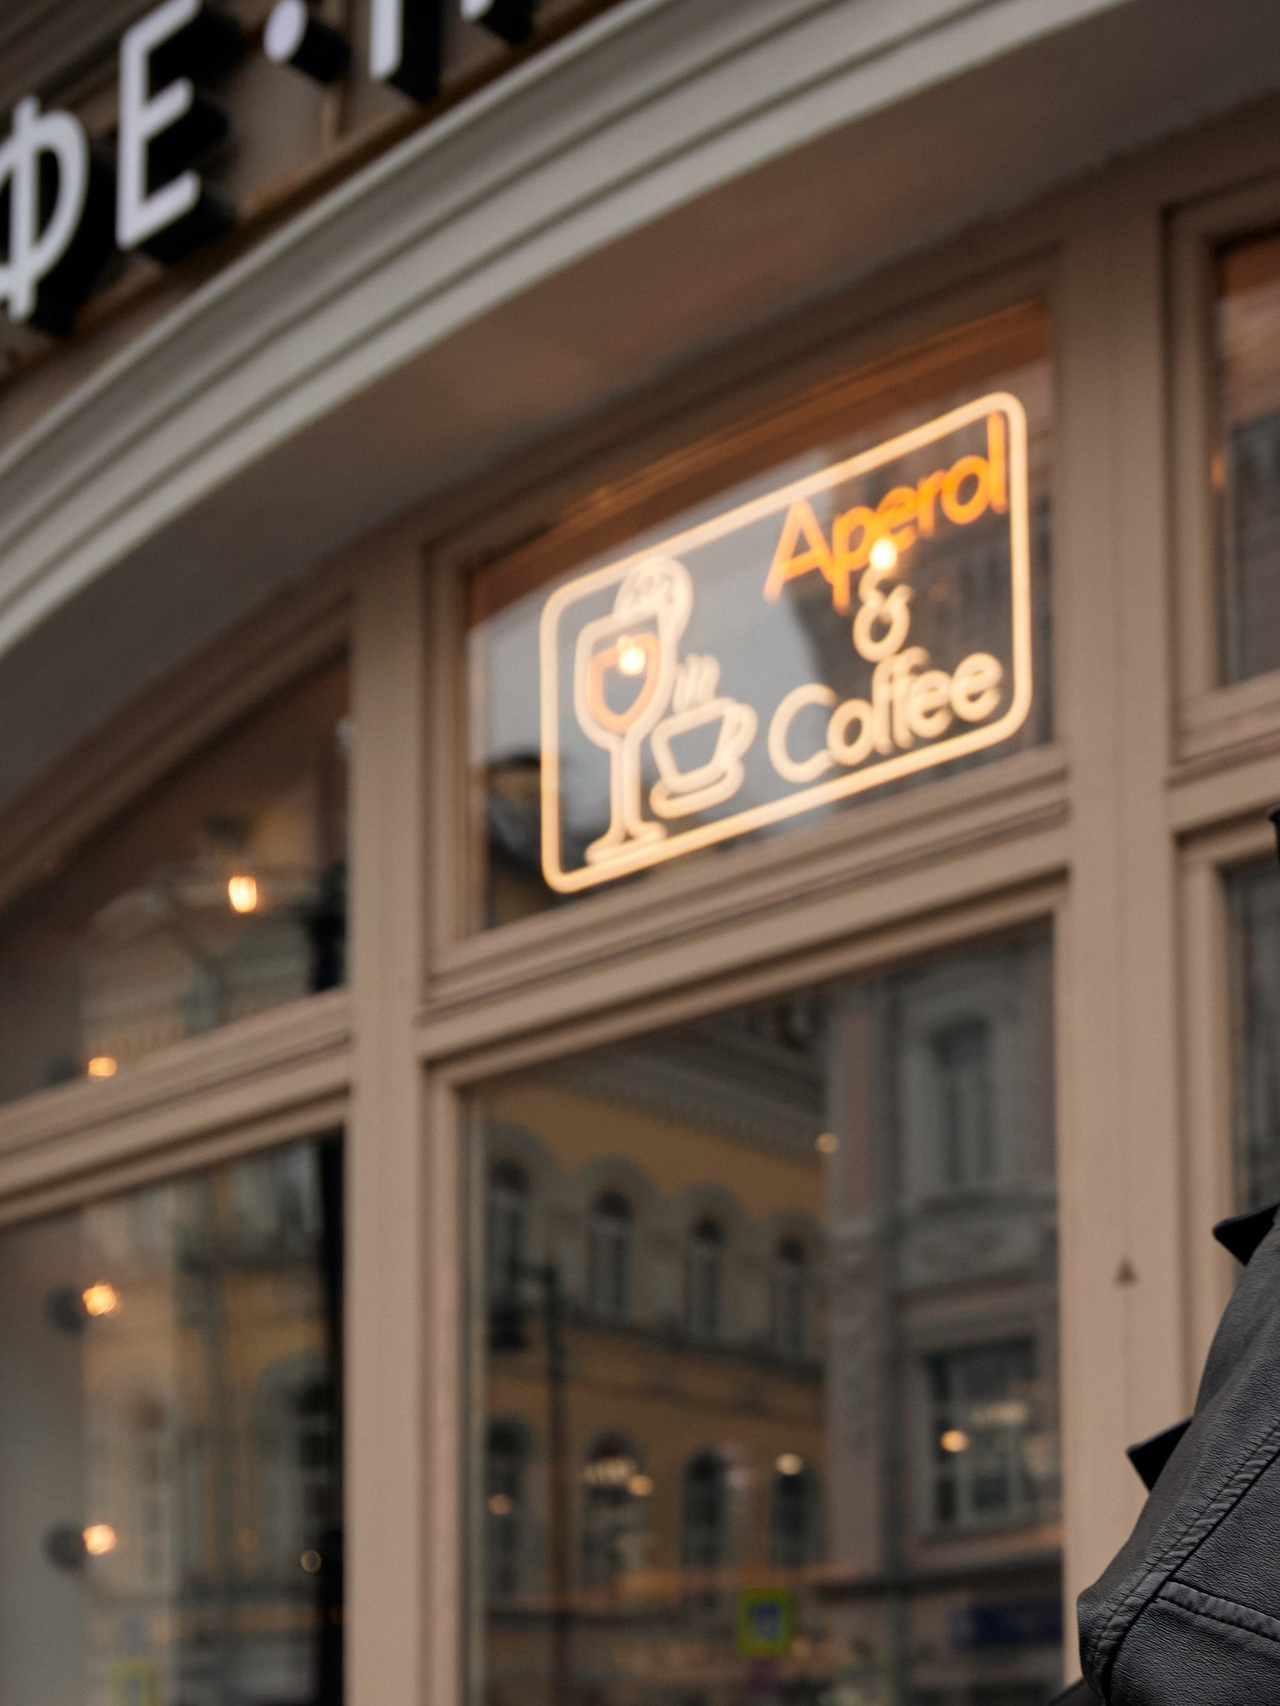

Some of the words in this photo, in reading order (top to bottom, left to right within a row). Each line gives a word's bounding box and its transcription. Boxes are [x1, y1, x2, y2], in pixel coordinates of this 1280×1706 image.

[763, 411, 1008, 614] Aperol
[852, 560, 913, 663] &
[768, 646, 1003, 784] Coffee
